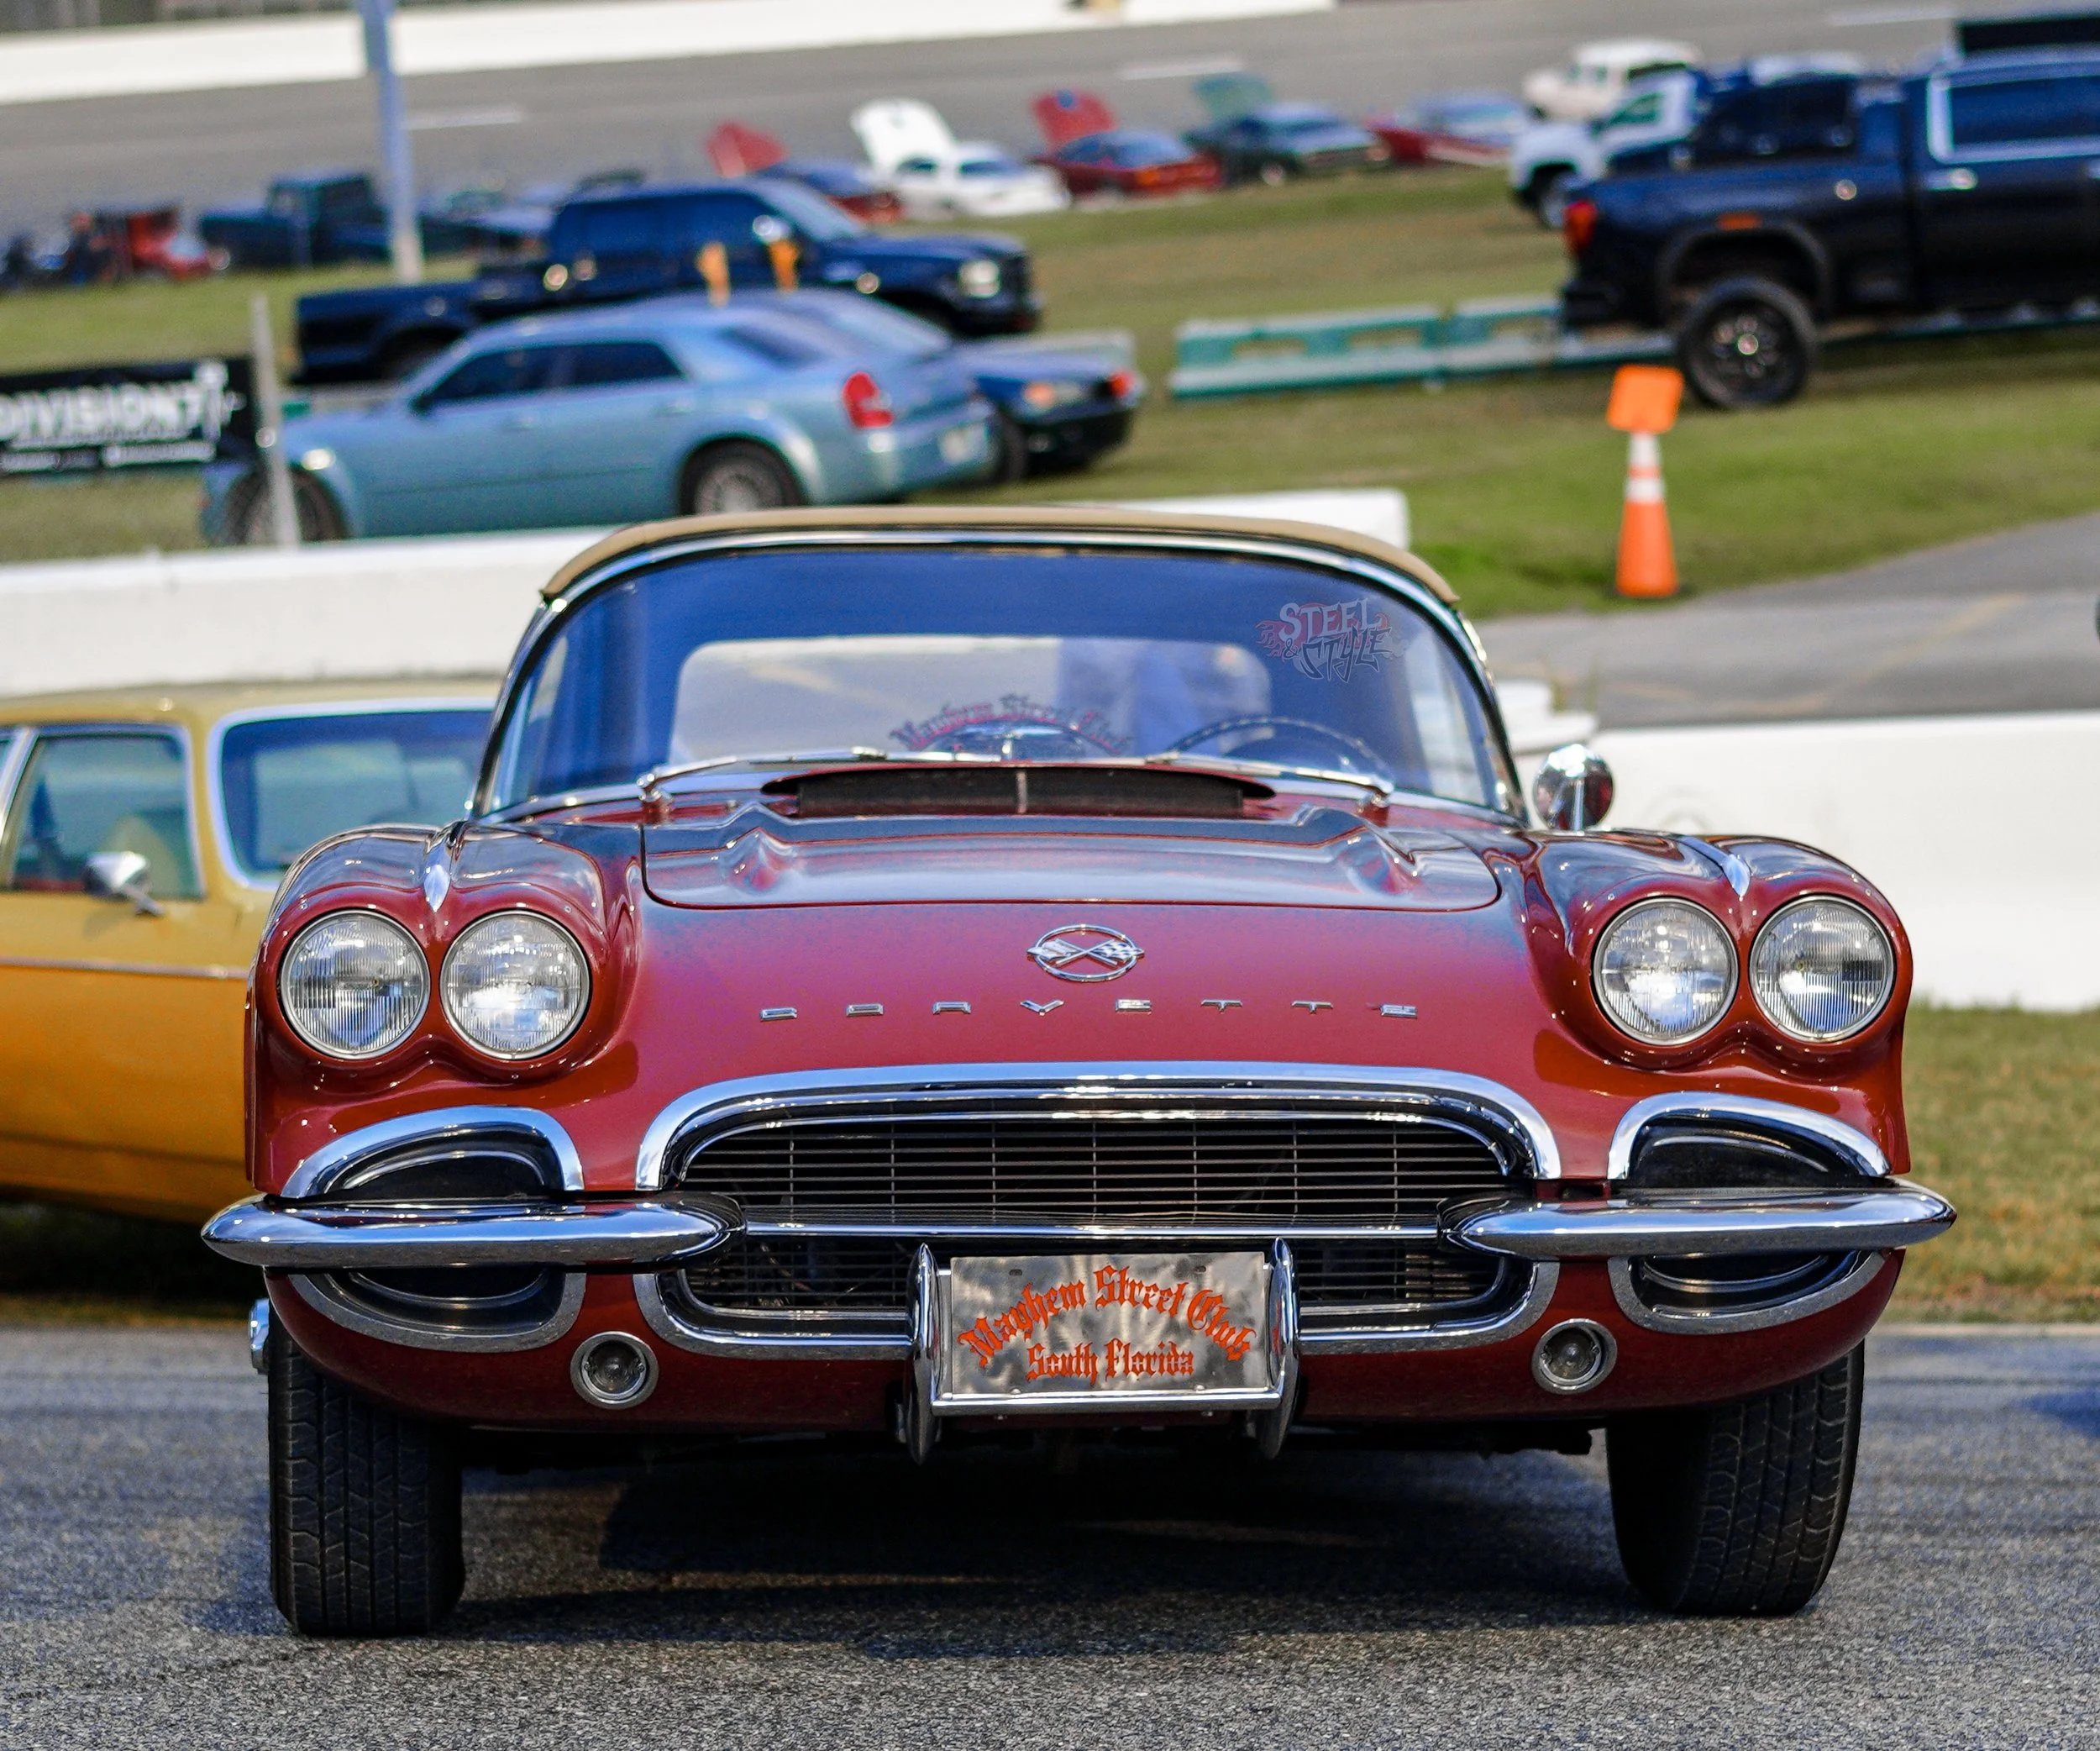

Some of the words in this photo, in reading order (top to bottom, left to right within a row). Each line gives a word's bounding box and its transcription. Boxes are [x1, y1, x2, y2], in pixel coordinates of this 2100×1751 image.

[759, 997, 1418, 1020] CORVETTE
[958, 1280, 1086, 1369] Mayhem
[1093, 1265, 1189, 1317] Street
[1186, 1289, 1257, 1362] Club
[1026, 1342, 1098, 1386] South
[1104, 1338, 1194, 1380] Florida
